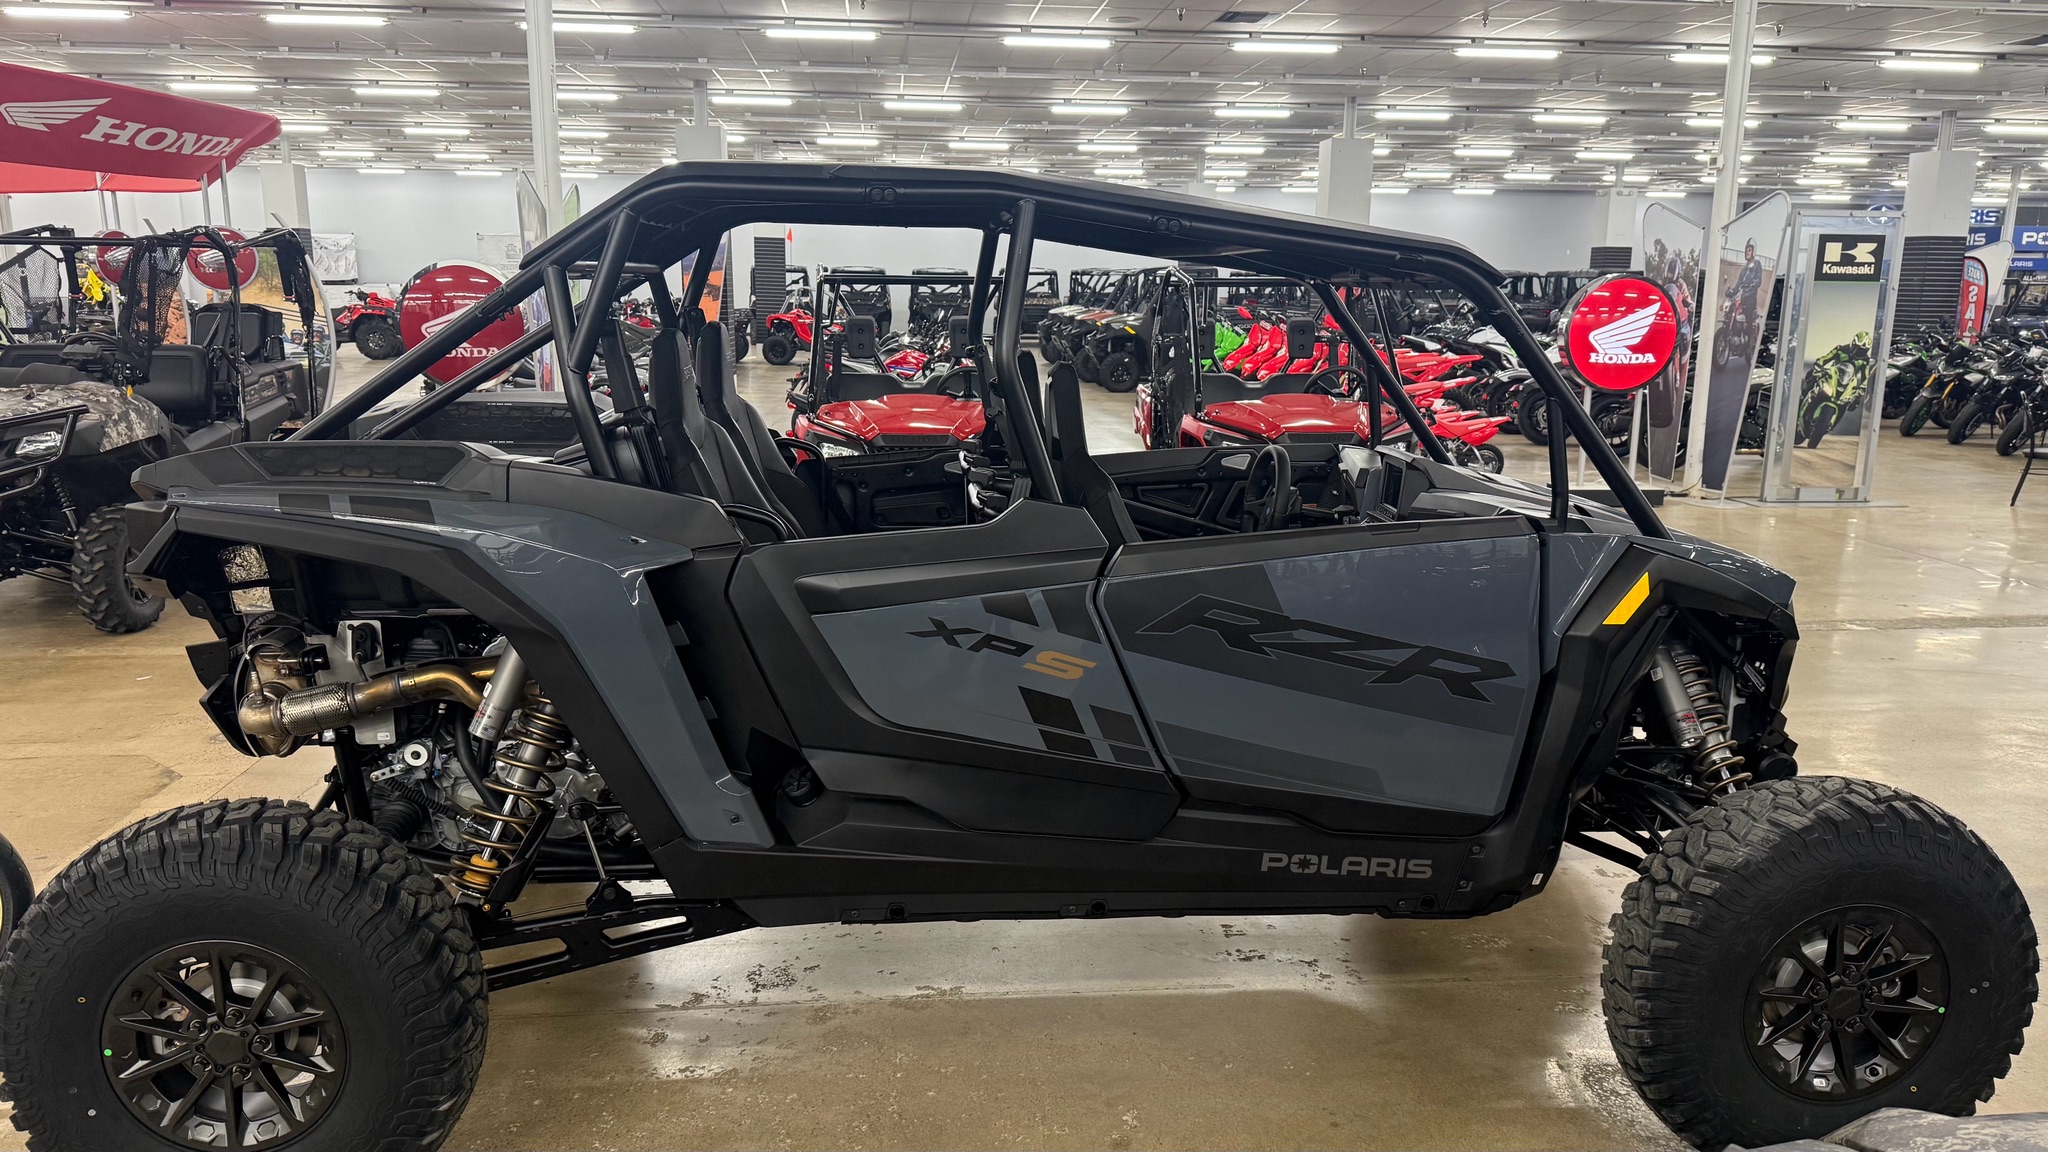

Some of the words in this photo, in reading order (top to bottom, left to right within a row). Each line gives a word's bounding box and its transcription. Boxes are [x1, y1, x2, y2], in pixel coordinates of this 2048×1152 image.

[80, 115, 243, 157] HONDA
[1822, 263, 1875, 275] Kawasaki
[1588, 352, 1656, 364] HONDA
[1136, 594, 1517, 704] RZR
[1260, 852, 1433, 878] POLARIS
